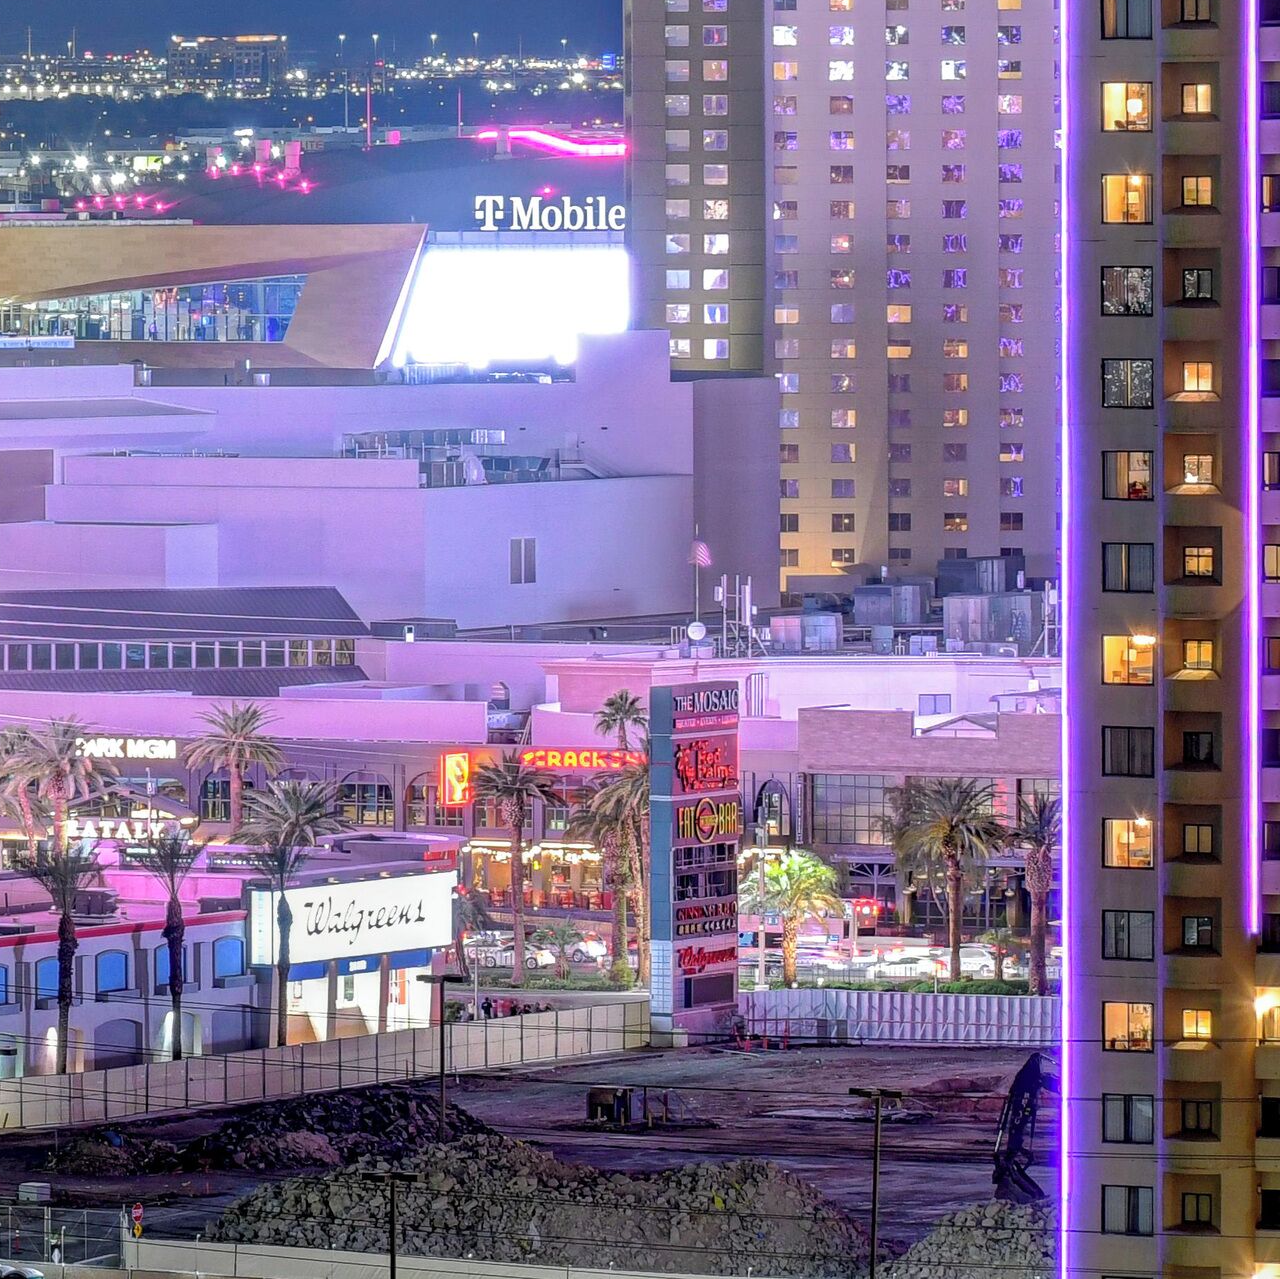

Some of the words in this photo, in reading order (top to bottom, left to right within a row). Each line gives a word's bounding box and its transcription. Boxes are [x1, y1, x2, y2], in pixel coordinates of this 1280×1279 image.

[509, 196, 626, 231] Mobile
[674, 696, 693, 712] THE
[693, 688, 739, 714] MOSAIC
[75, 738, 125, 758] PARK
[126, 739, 177, 759] MGM
[677, 806, 696, 838] FAT
[718, 802, 737, 835] BAR
[303, 896, 426, 945] Walgreens
